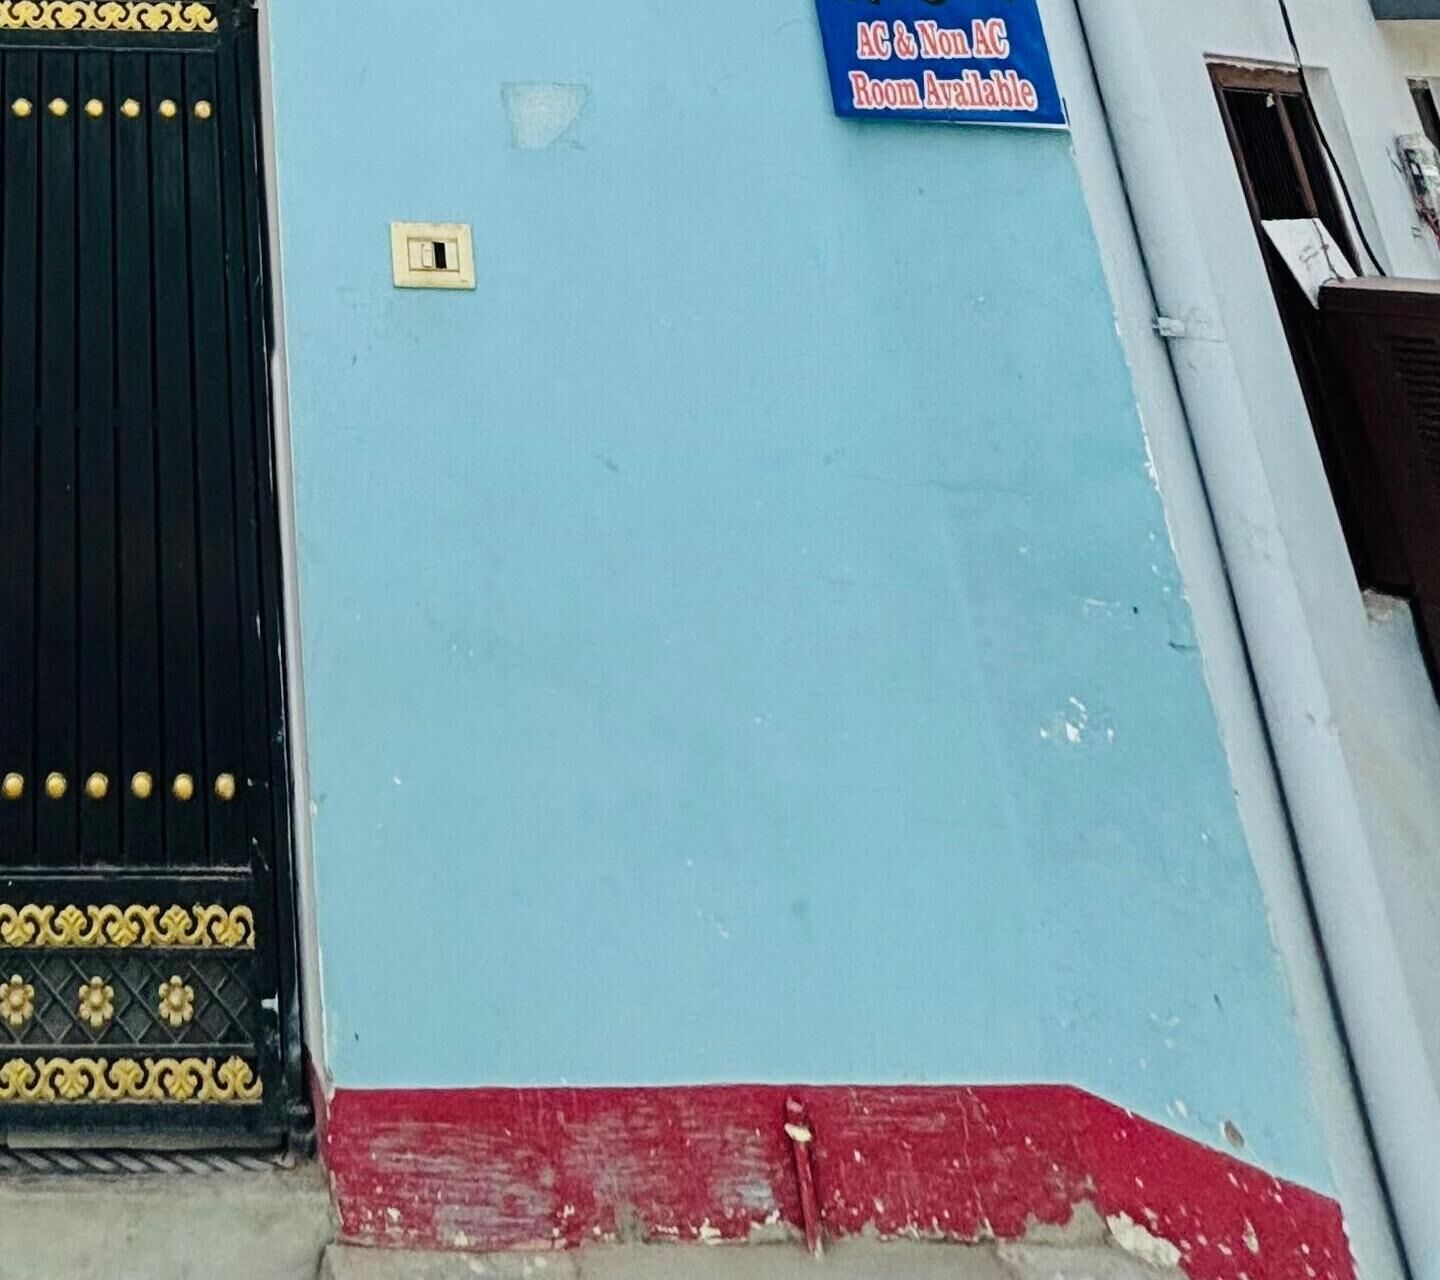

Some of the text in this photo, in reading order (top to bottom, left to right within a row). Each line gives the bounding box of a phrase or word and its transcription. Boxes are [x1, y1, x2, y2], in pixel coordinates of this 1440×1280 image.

[858, 18, 1009, 59] AC & Non AC
[849, 70, 1038, 111] Room Available
